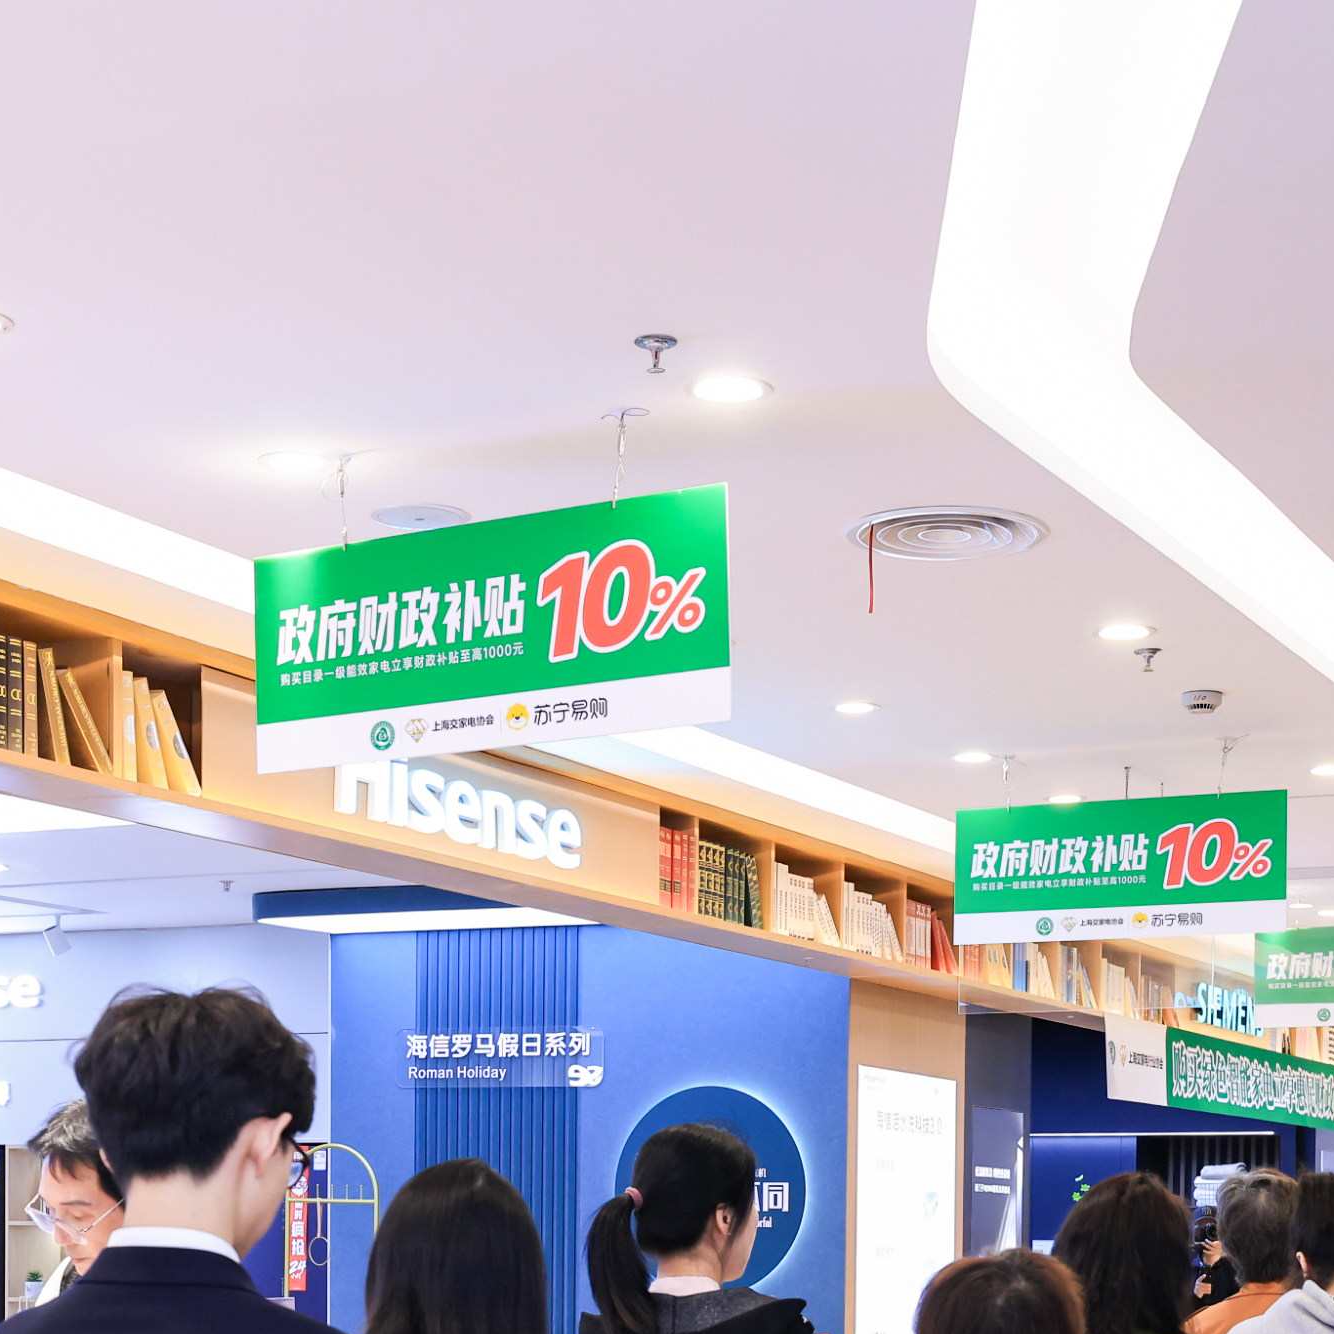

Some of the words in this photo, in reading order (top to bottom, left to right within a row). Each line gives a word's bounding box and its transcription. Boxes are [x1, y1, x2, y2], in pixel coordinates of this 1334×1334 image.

[276, 574, 526, 667] 政府财政补贴
[536, 539, 707, 663] 10%
[280, 641, 524, 687] 购买目录一级能效家电立享财政补贴至高1000元
[432, 713, 494, 733] 上海交家电协会
[534, 697, 608, 727] 苏宁易购
[333, 759, 583, 870] Hisense
[970, 833, 1150, 879] 政府财政补贴
[1156, 818, 1273, 890] 10%
[972, 874, 1147, 892] 购买目录一级能效家电立享财政补贴至高1000元
[1151, 912, 1203, 927] 苏宁易购
[1197, 981, 1265, 1038] SIEMEN
[406, 1032, 591, 1059] 海信罗马假日系列
[408, 1066, 453, 1079] Roman
[456, 1065, 507, 1081] Holiday
